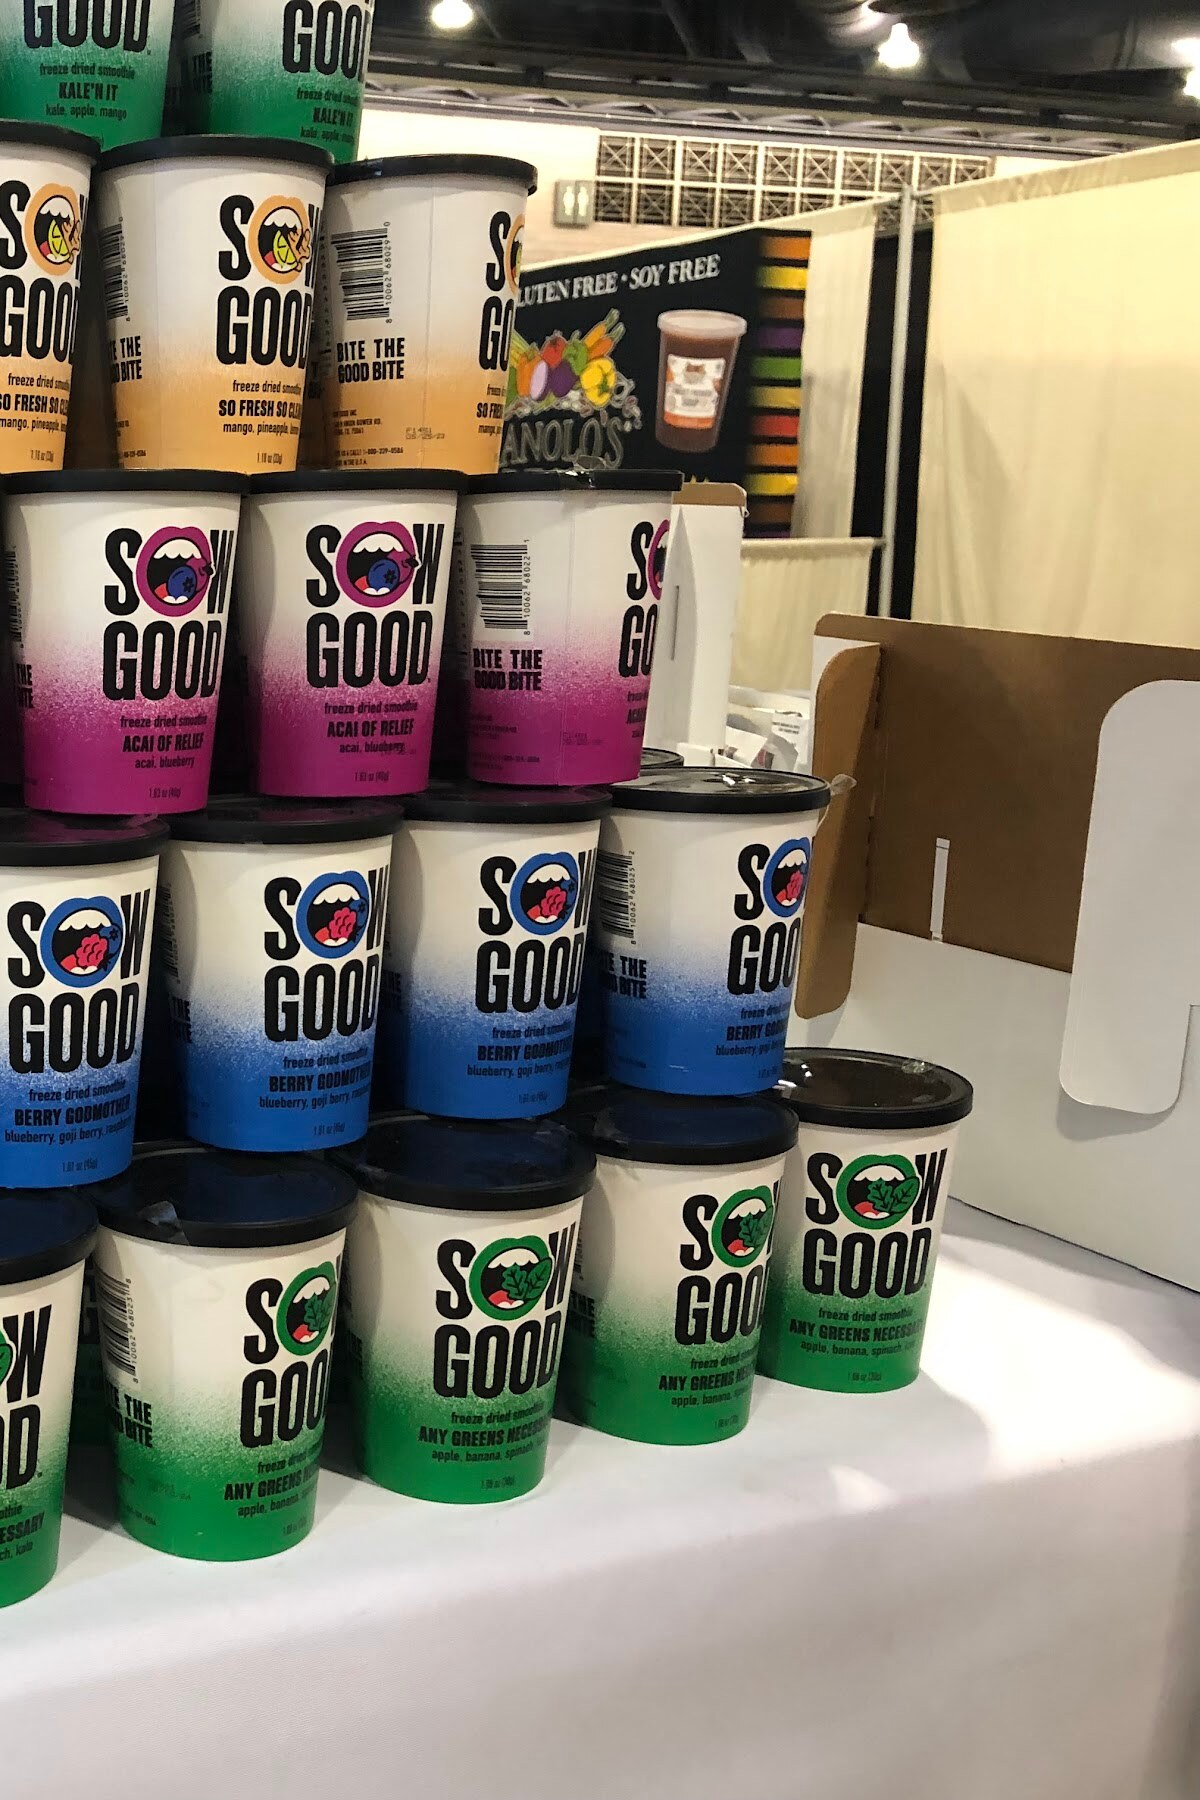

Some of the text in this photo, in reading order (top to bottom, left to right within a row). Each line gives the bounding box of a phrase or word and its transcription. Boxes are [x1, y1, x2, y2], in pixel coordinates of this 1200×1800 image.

[40, 62, 135, 79] freeze dried smoothie
[59, 82, 118, 100] KALE'N IT
[100, 108, 126, 121] mango
[518, 254, 720, 307] LUTEN FREE SOY FREE
[337, 337, 405, 362] BITE THE
[338, 360, 405, 383] GOOD BITE
[305, 520, 445, 608] SOW
[102, 619, 222, 702] GOOD
[305, 610, 434, 689] GOOD
[327, 718, 414, 738] ACAI OF RELIEF
[8, 982, 139, 1075] GOOD
[806, 1148, 947, 1230] SOW
[802, 1227, 932, 1299] GOOD
[433, 1310, 563, 1400] GOOD
[15, 1542, 34, 1555] kale
